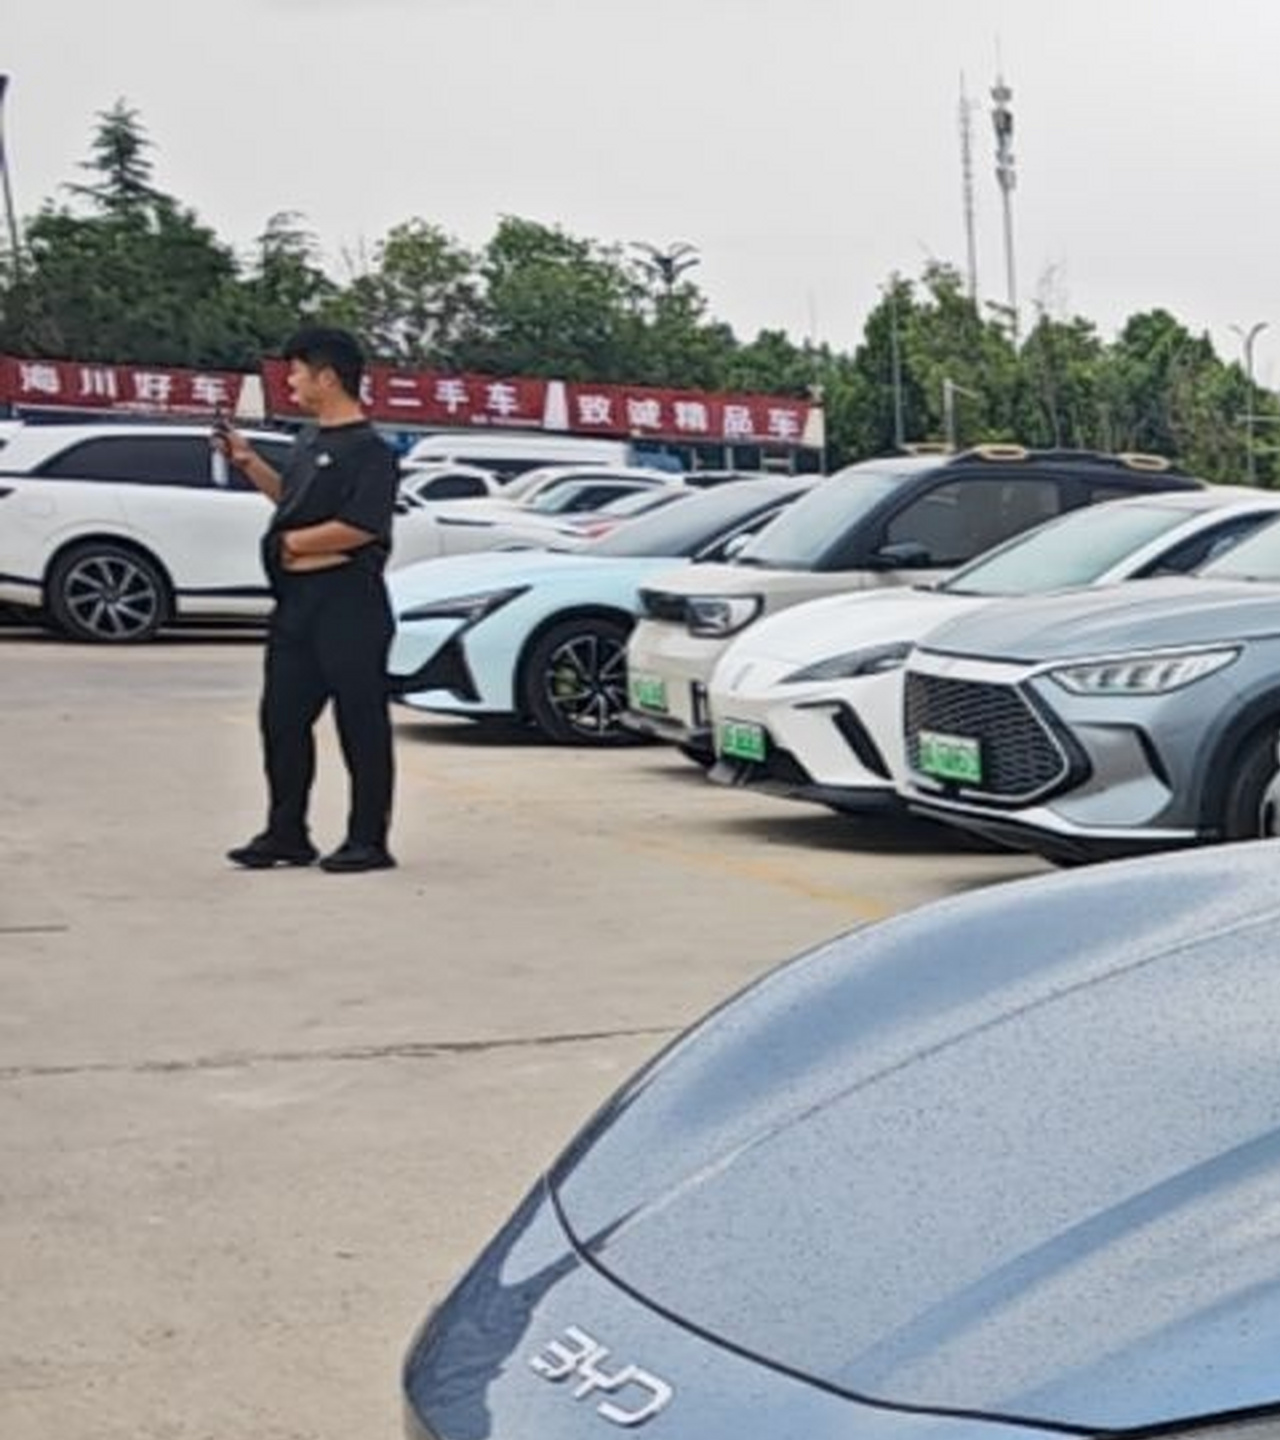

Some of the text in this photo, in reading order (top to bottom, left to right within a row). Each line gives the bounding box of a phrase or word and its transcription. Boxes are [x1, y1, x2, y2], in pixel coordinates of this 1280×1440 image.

[358, 373, 518, 415] 二手车
[529, 1325, 672, 1424] BYD
